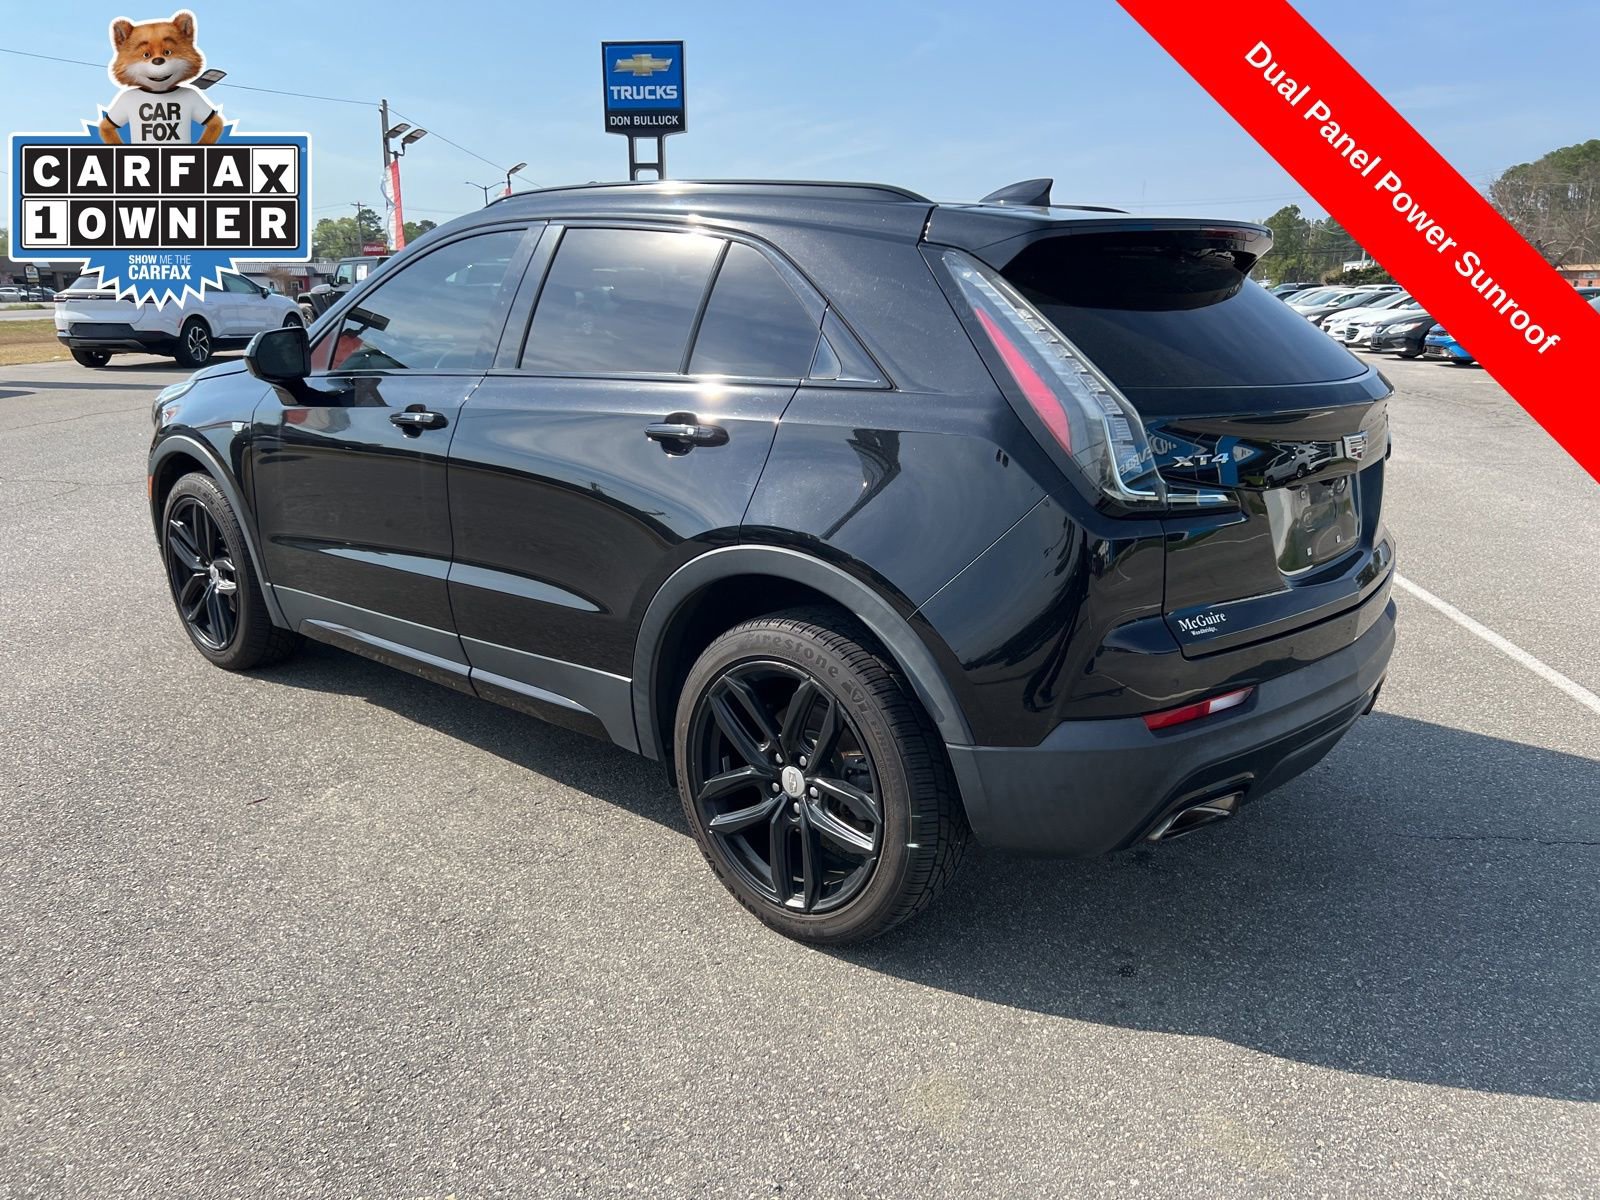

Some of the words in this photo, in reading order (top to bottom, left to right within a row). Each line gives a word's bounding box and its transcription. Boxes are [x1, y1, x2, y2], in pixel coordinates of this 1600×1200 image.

[610, 85, 678, 100] TRUCKS
[610, 116, 631, 126] DON
[633, 115, 679, 126] BULLUCK
[1172, 453, 1229, 468] XT4
[1178, 611, 1227, 632] McGuire
[737, 631, 840, 679] Firestone
